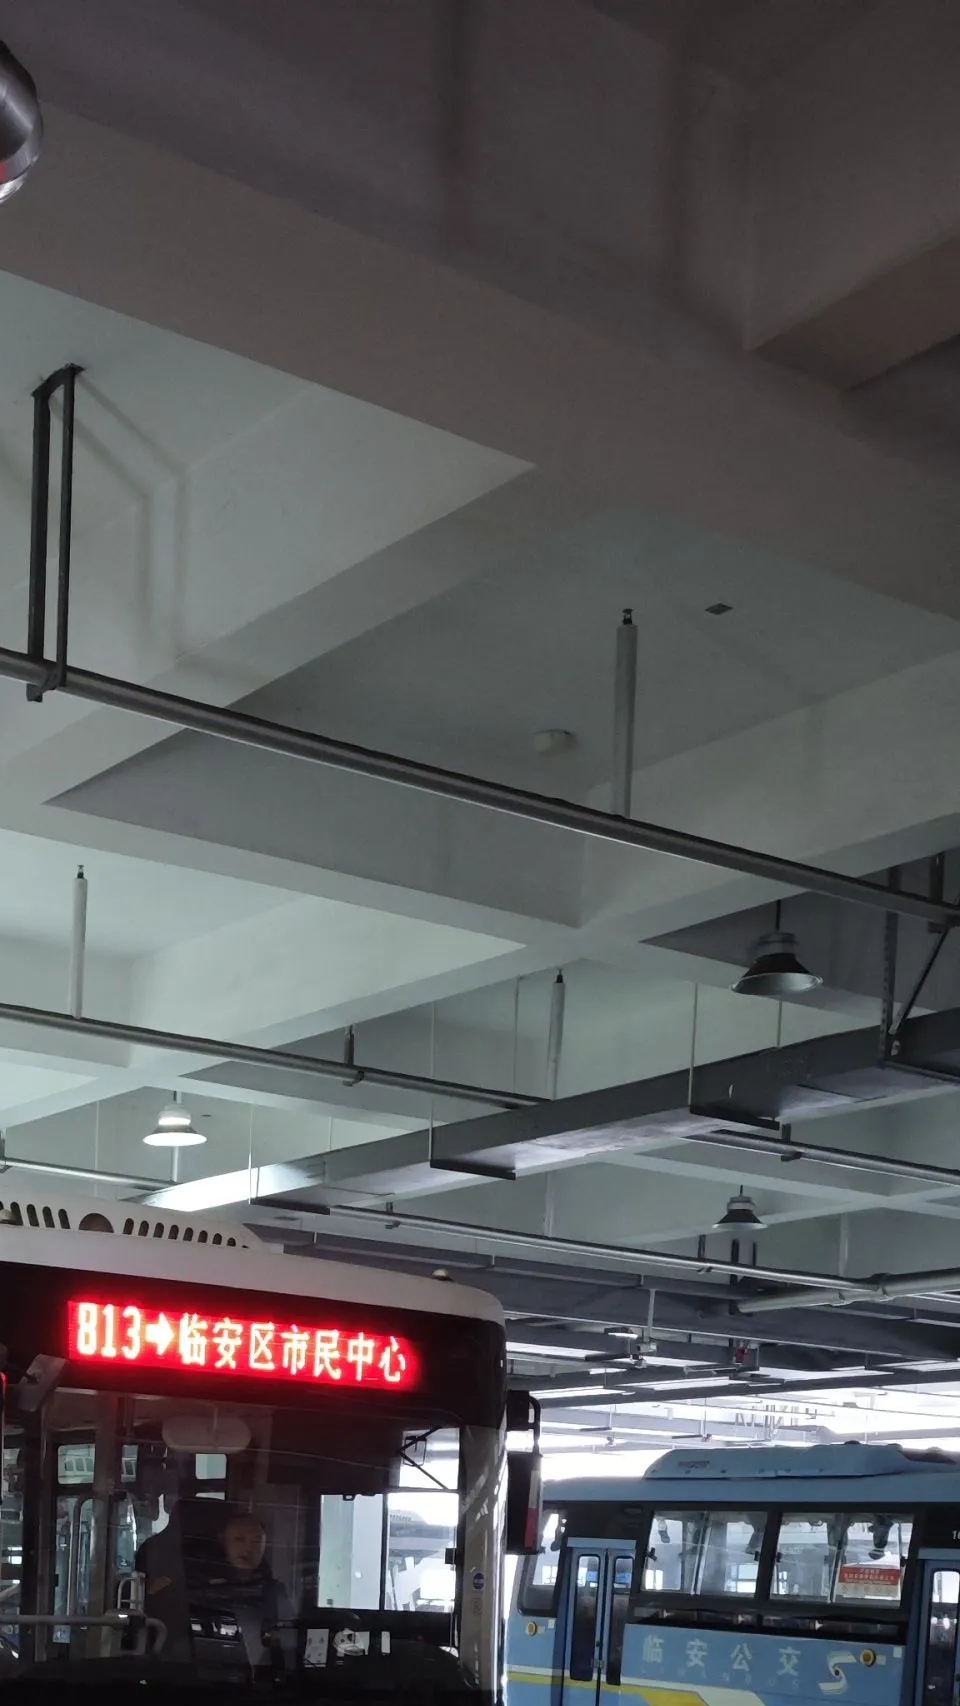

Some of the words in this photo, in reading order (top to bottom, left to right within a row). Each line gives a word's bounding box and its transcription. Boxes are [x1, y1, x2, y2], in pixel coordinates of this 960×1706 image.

[77, 1302, 141, 1359] 813
[178, 1312, 407, 1383] 临安区市民中心
[642, 1634, 801, 1677] 临安公交
